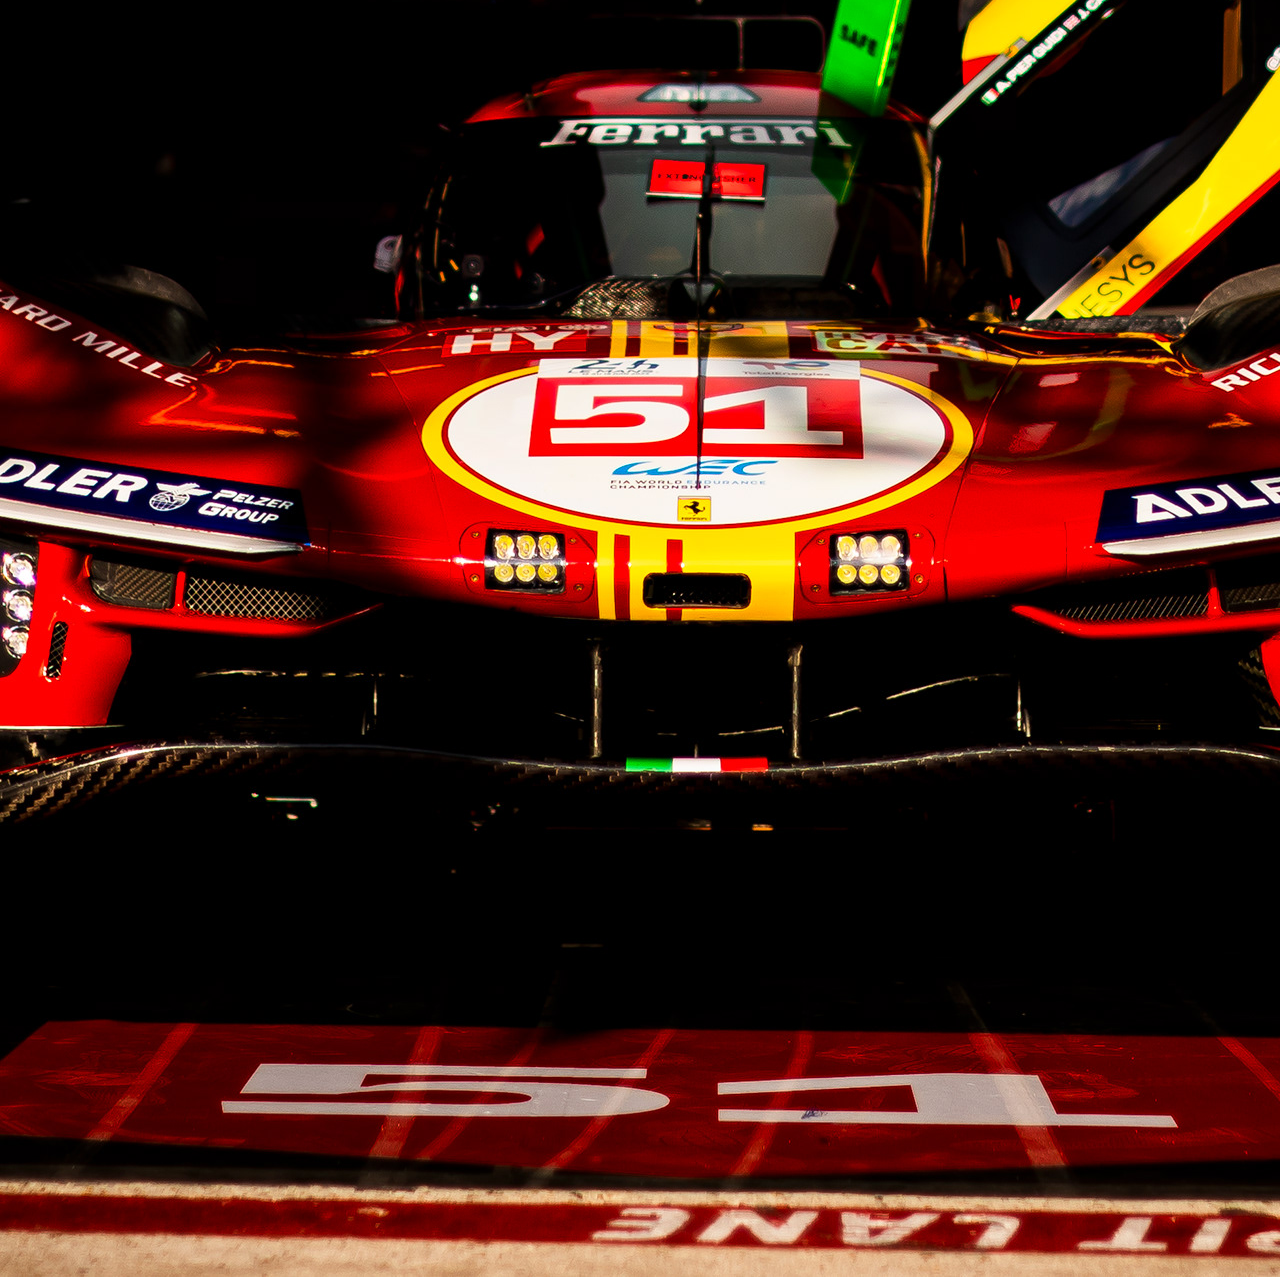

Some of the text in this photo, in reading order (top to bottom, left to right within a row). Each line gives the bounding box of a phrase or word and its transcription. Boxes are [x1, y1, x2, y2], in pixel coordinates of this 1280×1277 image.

[995, 80, 1012, 94] A.
[1006, 54, 1037, 83] PIER
[1032, 26, 1067, 59] GUIDI
[1078, 8, 1090, 21] J.
[540, 118, 852, 147] Ferrari
[72, 331, 198, 387] MILLE
[550, 383, 844, 446] 51
[198, 503, 280, 524] GROUP
[211, 489, 294, 511] PELZER
[221, 1063, 1179, 1128] 51
[588, 1208, 1020, 1250] LANE
